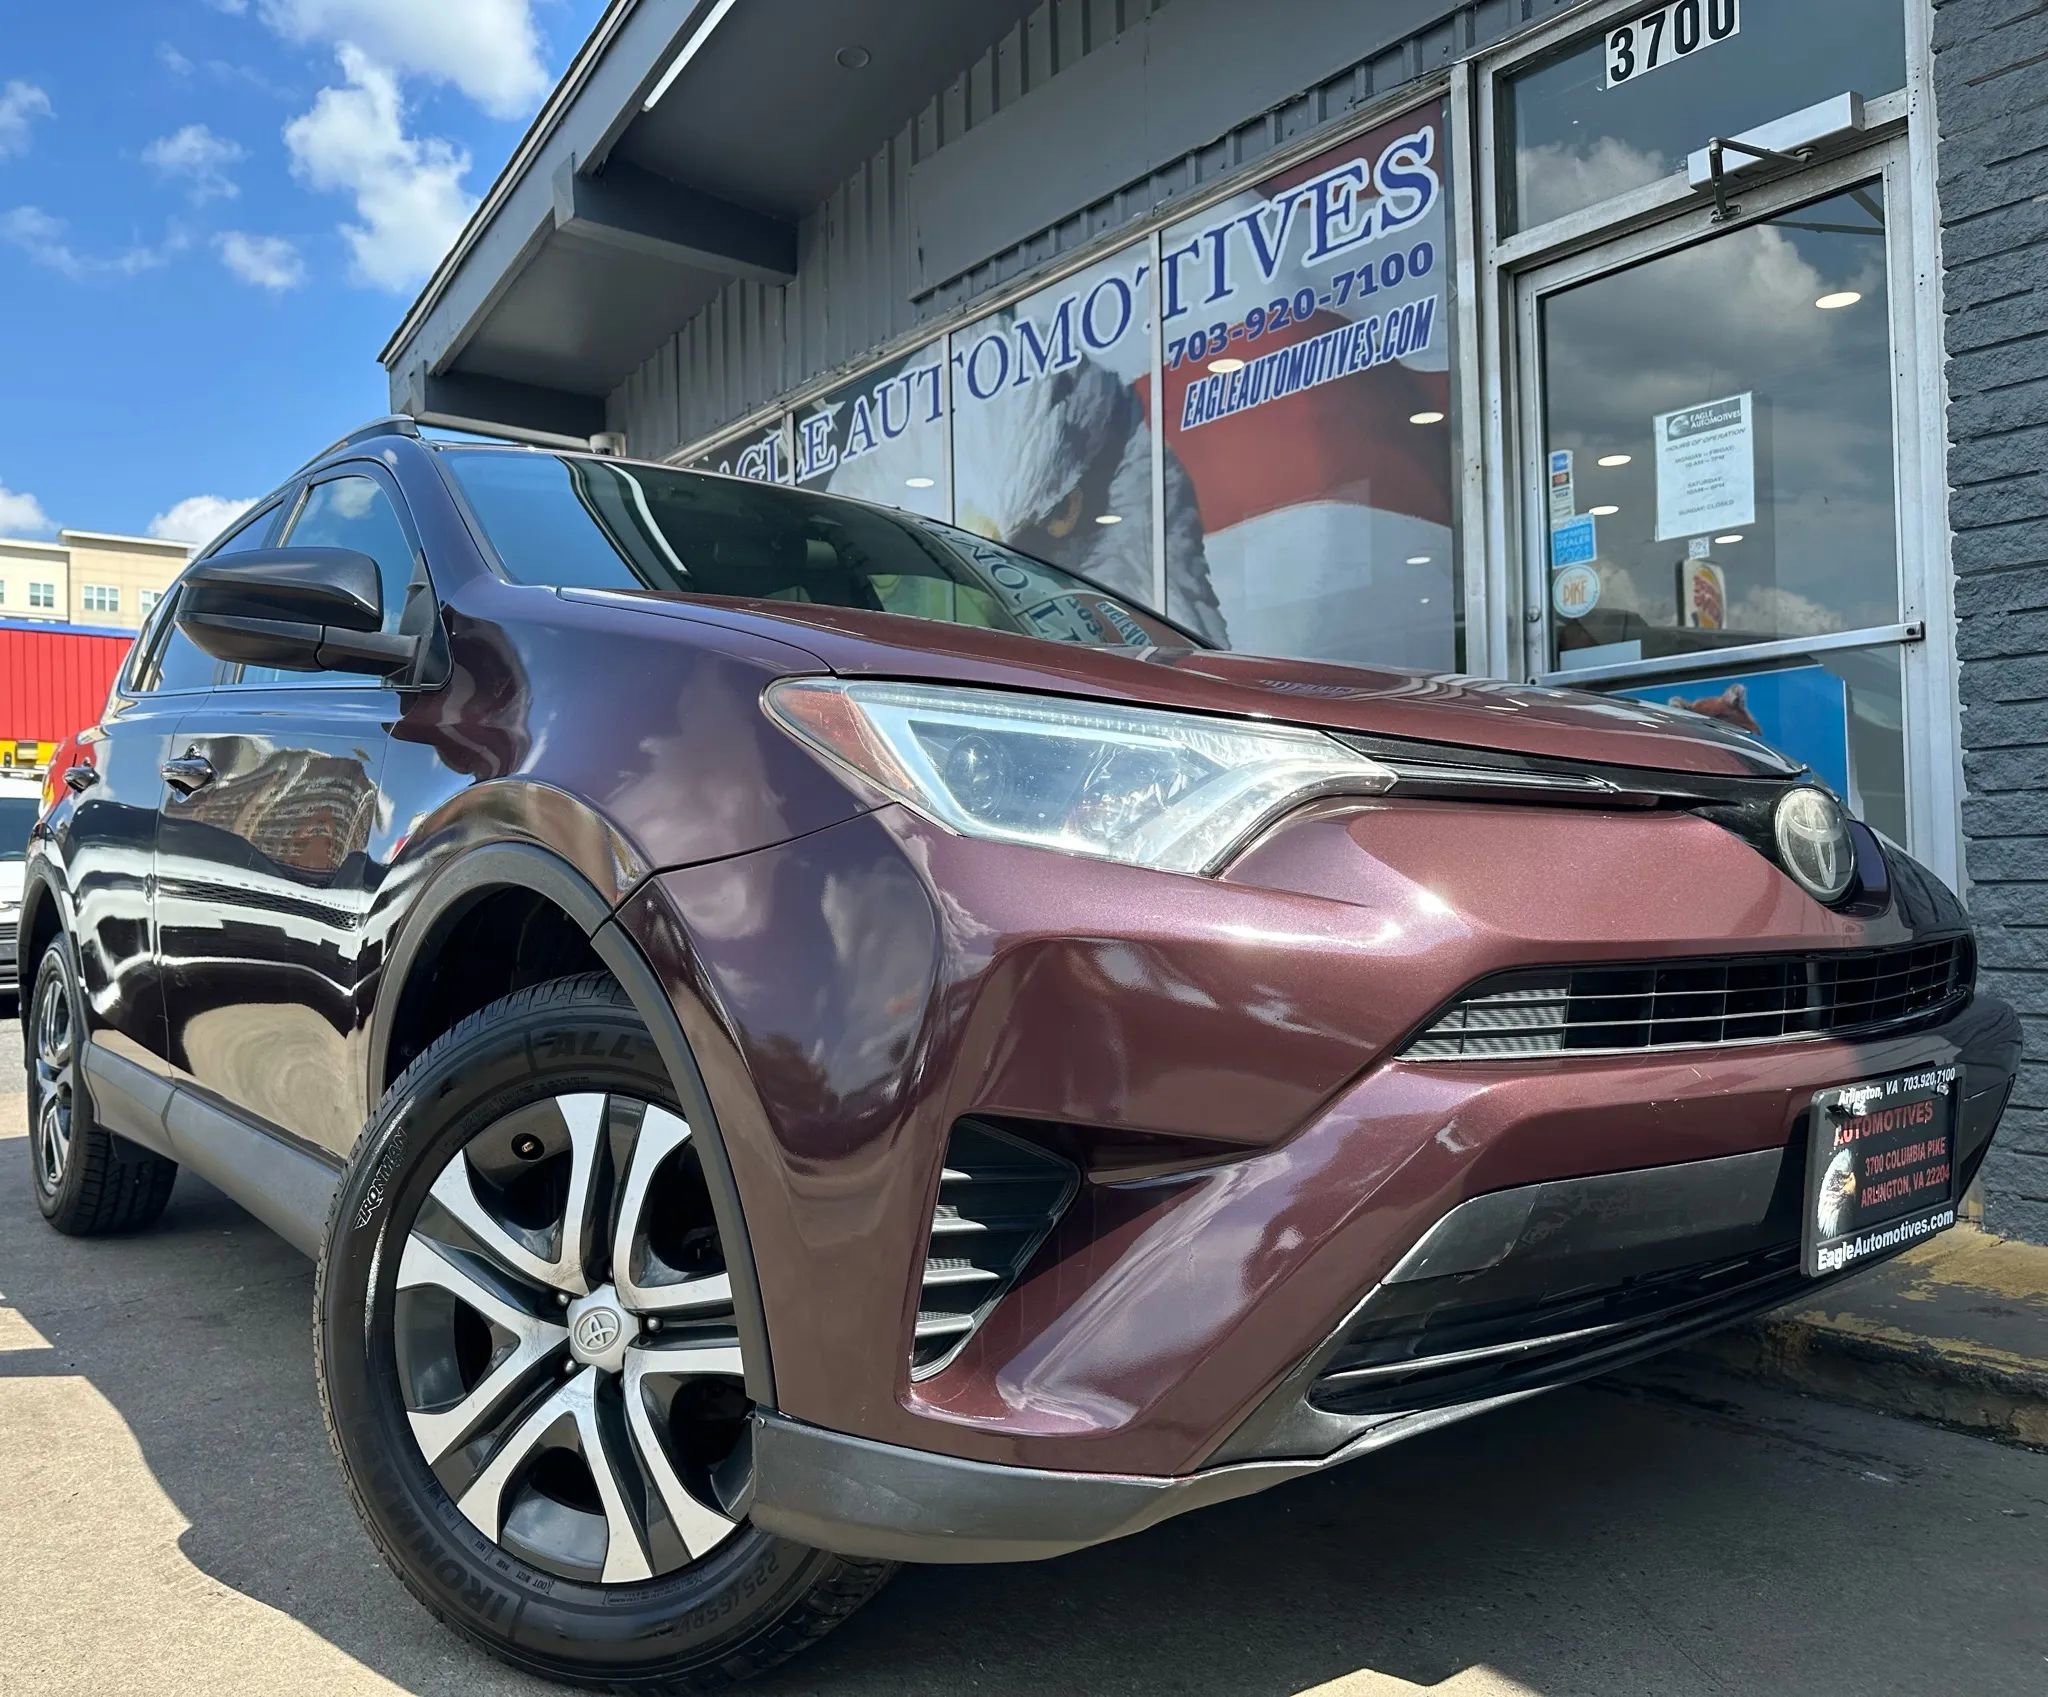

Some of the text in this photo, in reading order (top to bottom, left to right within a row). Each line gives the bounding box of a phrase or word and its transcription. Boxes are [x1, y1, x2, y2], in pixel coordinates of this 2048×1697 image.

[1610, 0, 1735, 82] 3700
[841, 125, 1440, 463] AUTOMOTIVES
[1168, 241, 1433, 371] 703-920-7100
[1180, 294, 1438, 431] EAGLEAUTOMOTIVES.COM
[1689, 409, 1714, 422] EAGLE
[1690, 409, 1741, 429] AUTOMOTIVES
[1556, 535, 1591, 549] DEALER
[1563, 579, 1587, 606] PIKE
[1838, 1068, 1956, 1105] Arlington, VA 703.920.7100
[354, 1126, 408, 1229] IRONMAN
[1865, 1137, 1947, 1177] 3700 COLUMBIA PIKE
[1861, 1163, 1950, 1208] ARLINGTON, VA 22204
[1817, 1209, 1954, 1271] EagleAutomotives.com
